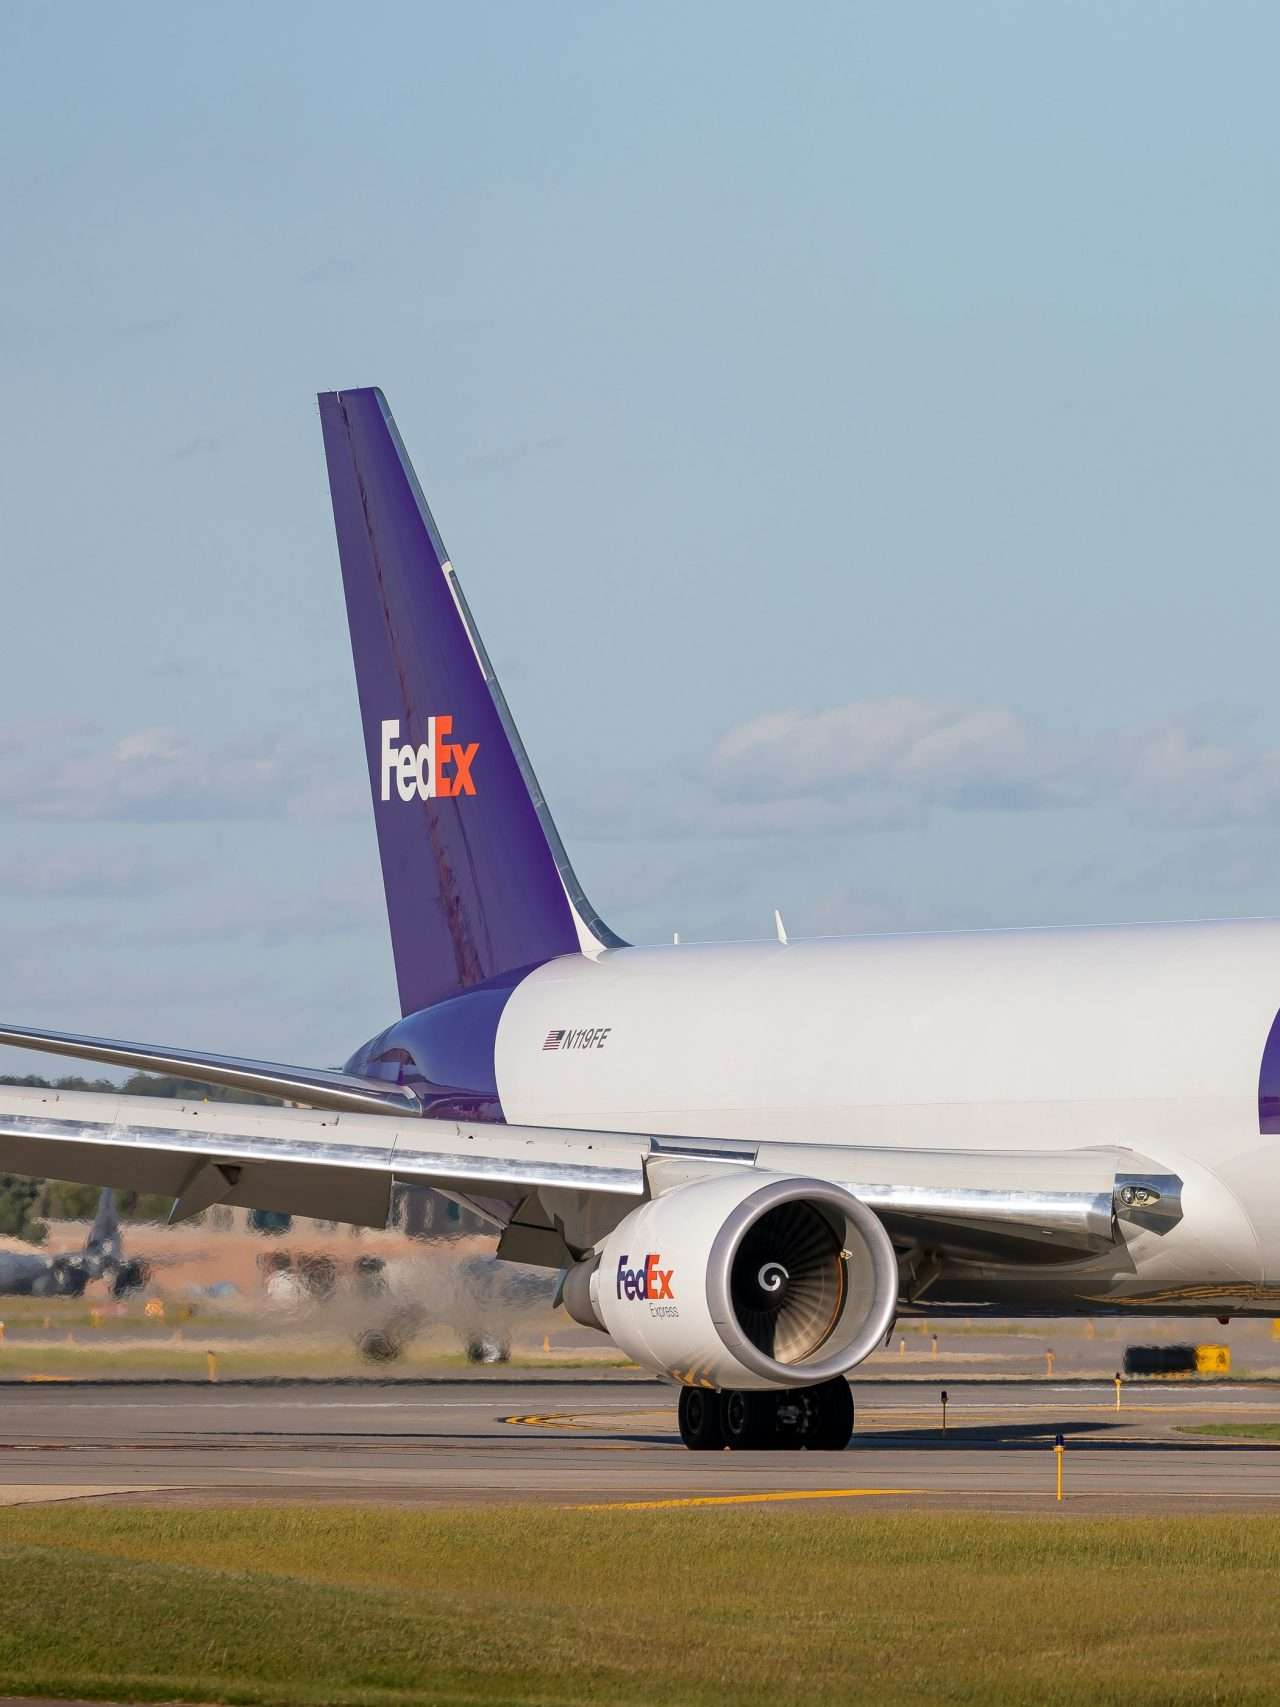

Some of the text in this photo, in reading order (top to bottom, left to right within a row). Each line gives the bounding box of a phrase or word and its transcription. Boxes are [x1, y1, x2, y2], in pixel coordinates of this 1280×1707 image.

[381, 715, 480, 802] FedEx
[561, 1028, 612, 1050] N119FE
[616, 1254, 674, 1301] FedEx
[649, 1302, 680, 1320] Express
